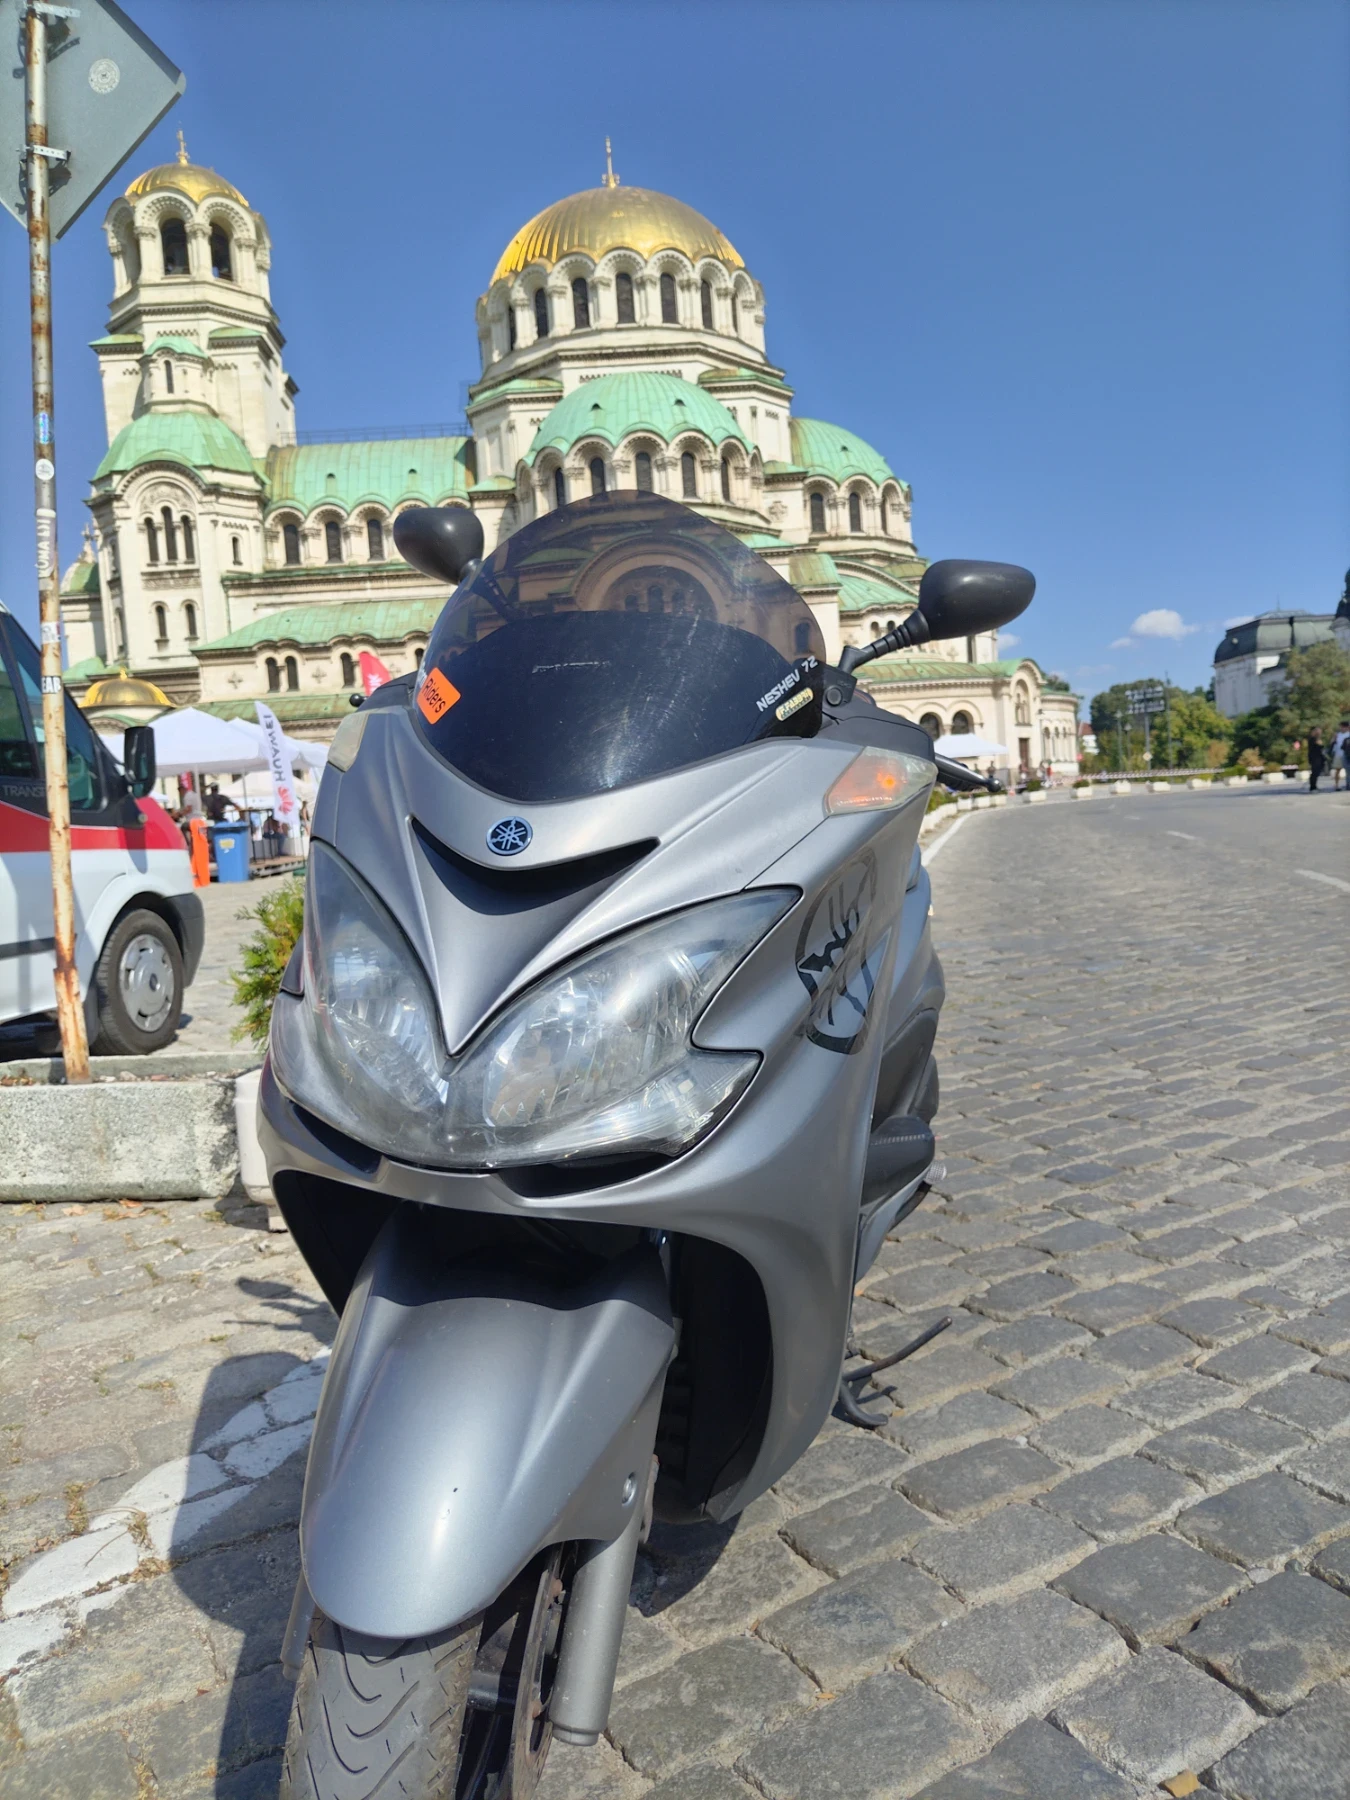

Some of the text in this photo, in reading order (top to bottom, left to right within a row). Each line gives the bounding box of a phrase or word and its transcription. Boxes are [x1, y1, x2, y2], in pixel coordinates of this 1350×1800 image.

[422, 677, 446, 714] Riders
[756, 669, 801, 712] NESHEV
[801, 655, 818, 673] 72
